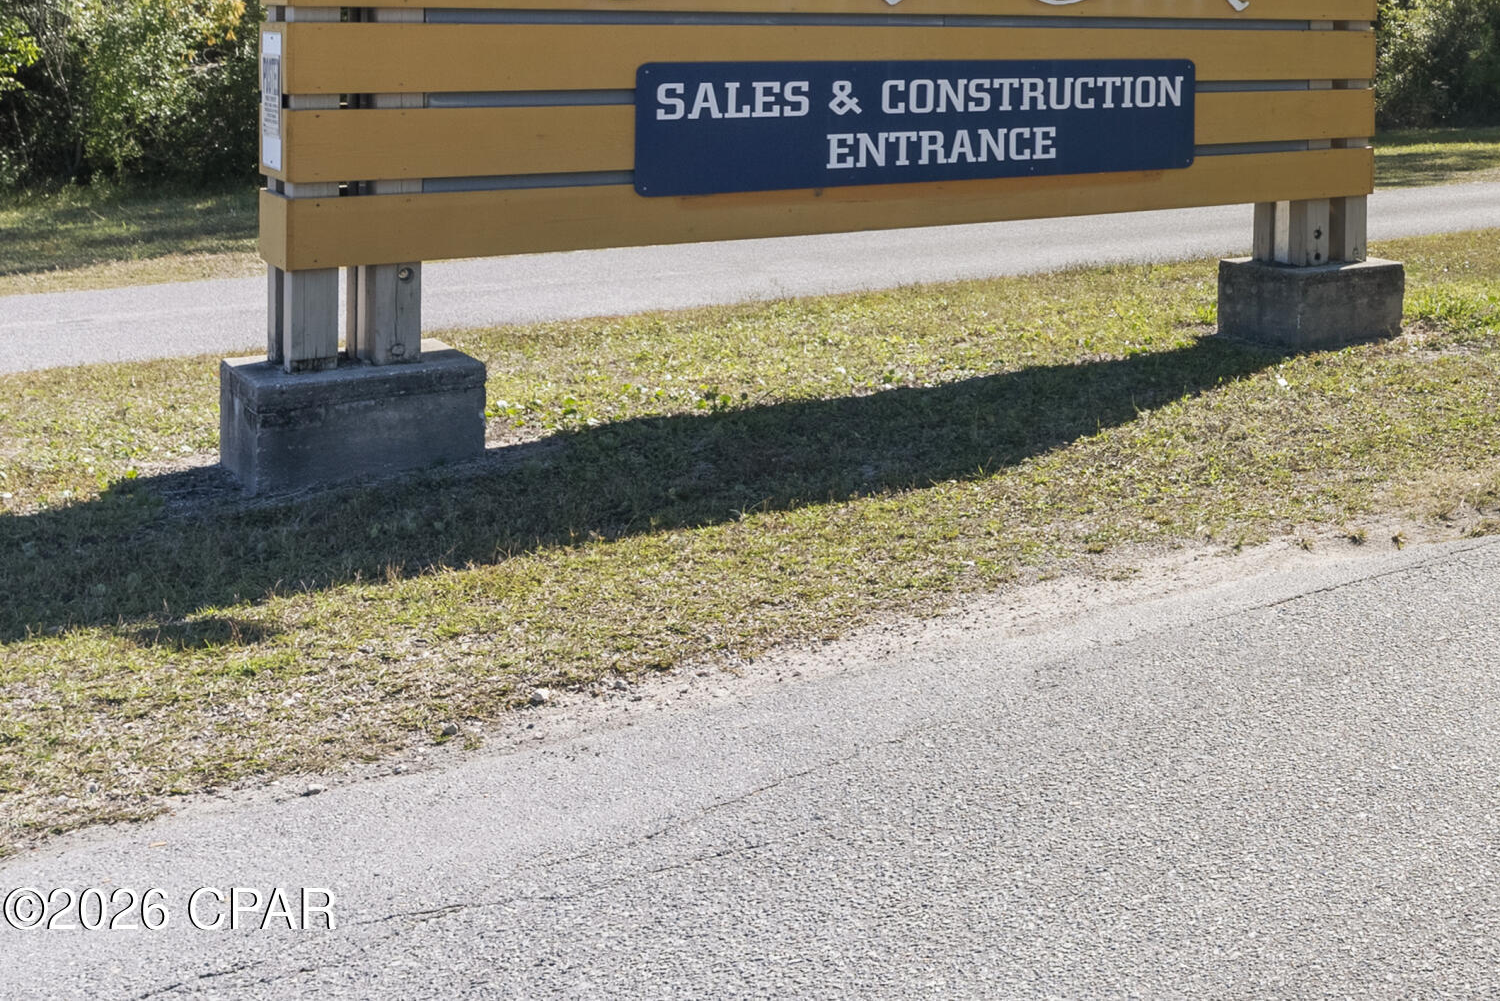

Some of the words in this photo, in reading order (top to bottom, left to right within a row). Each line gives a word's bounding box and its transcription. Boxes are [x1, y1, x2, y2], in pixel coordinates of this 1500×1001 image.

[656, 81, 810, 120] SALES
[829, 80, 862, 115] &
[881, 76, 1184, 114] CONSTRUCTION
[826, 127, 1057, 169] ENTRANCE
